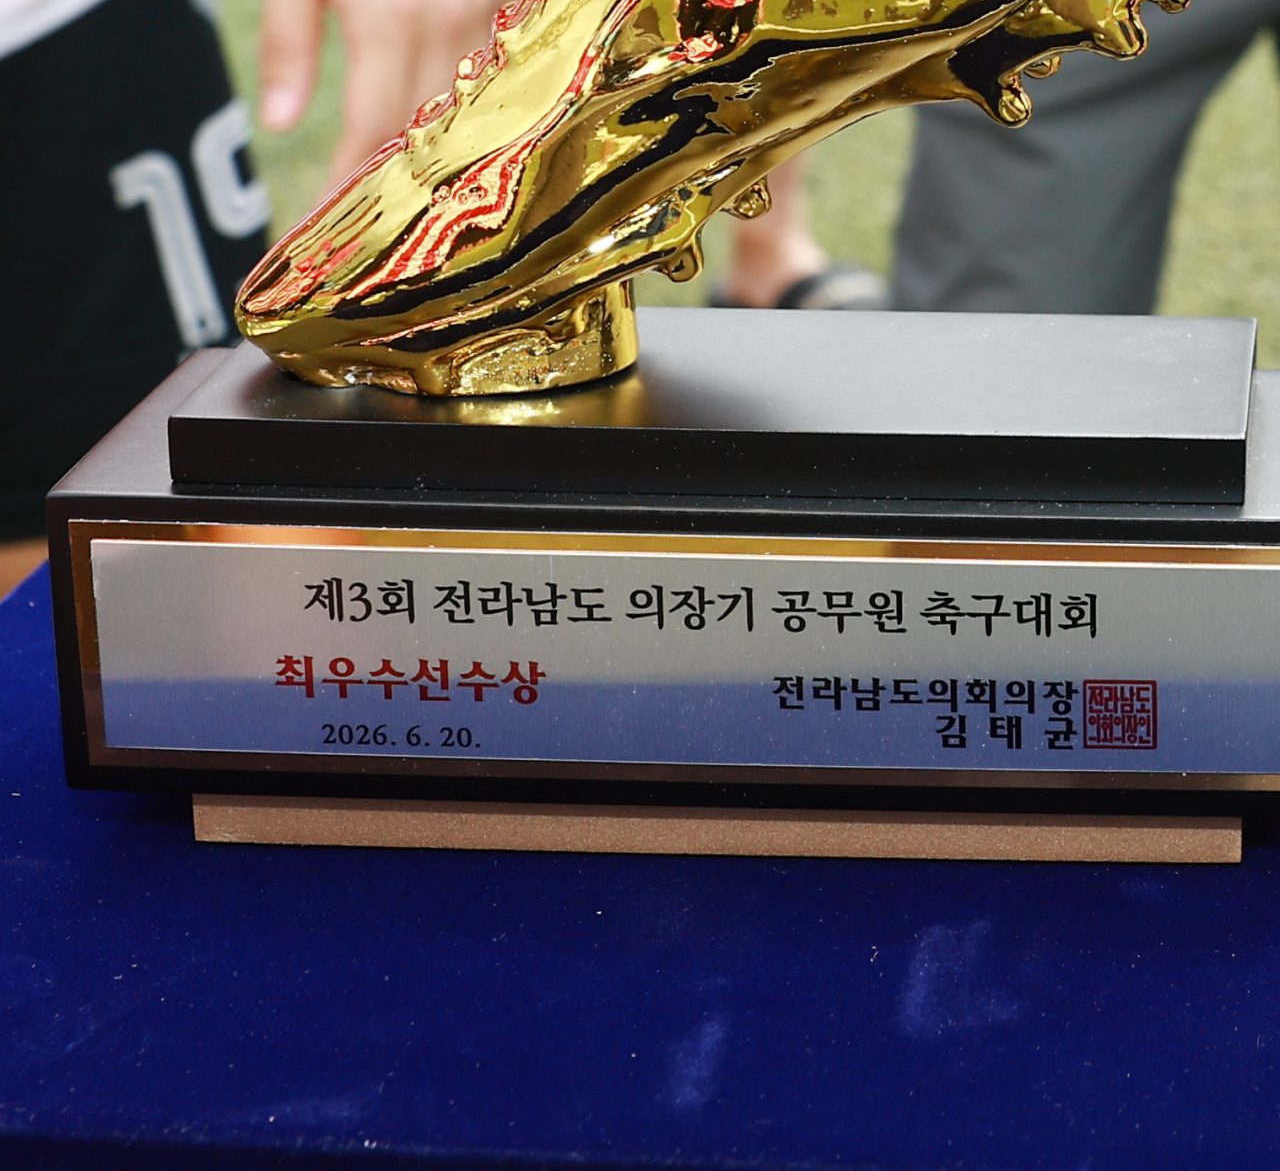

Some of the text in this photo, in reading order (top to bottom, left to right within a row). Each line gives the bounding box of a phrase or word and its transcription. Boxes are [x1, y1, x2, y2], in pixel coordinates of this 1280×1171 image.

[304, 577, 1098, 639] 제3회 전라남도 의장기 공무원 축구대회
[275, 654, 546, 705] 최우수선수상
[772, 675, 1080, 715] 전라남도의회의장
[321, 723, 482, 749] 2026. 6. 20.
